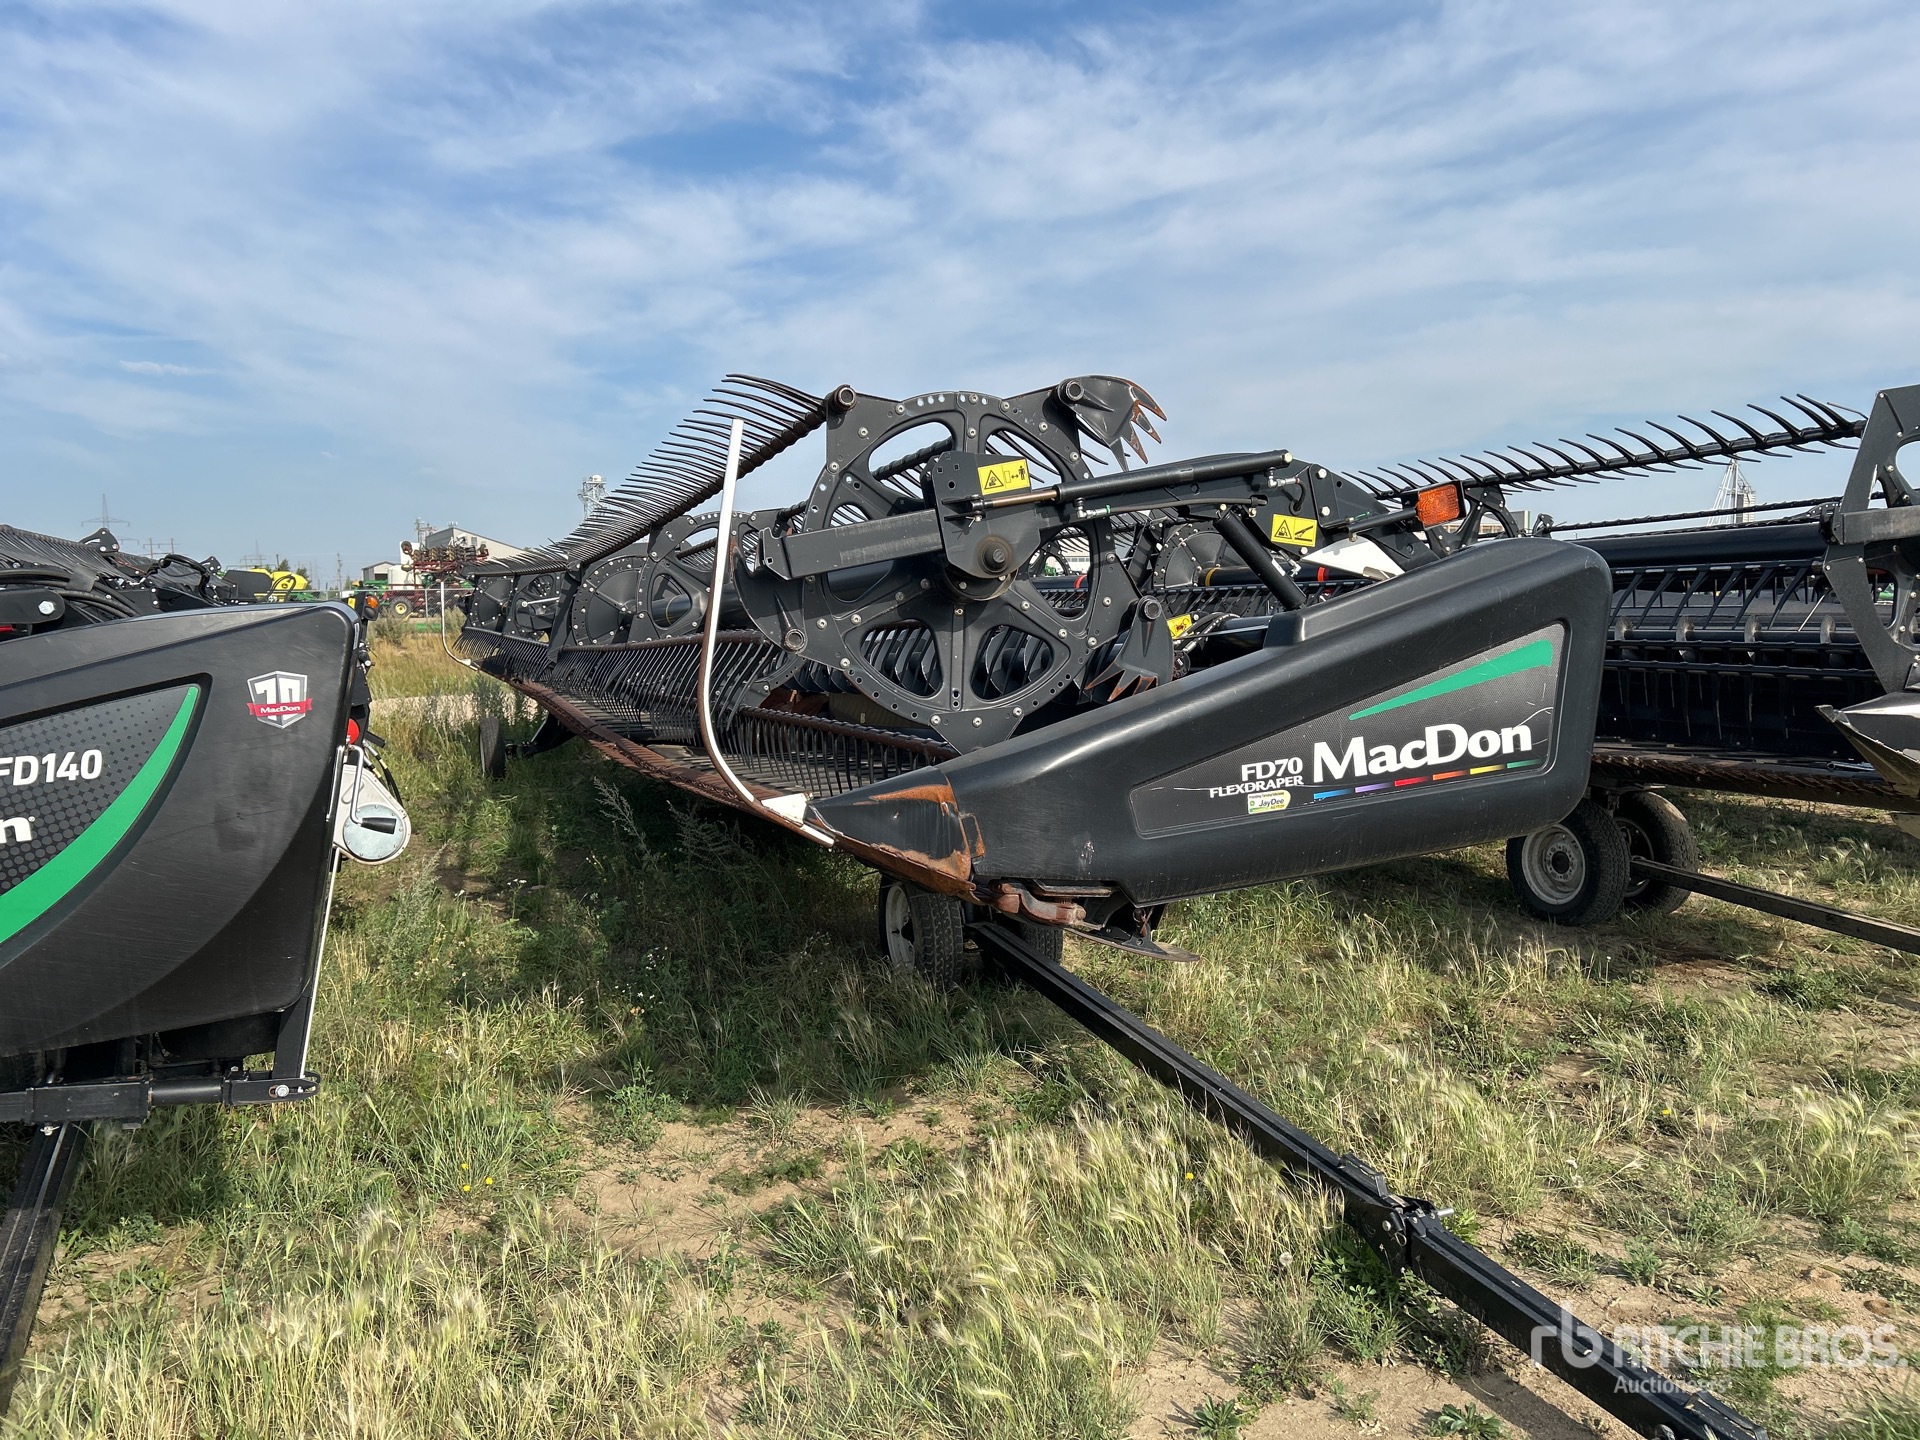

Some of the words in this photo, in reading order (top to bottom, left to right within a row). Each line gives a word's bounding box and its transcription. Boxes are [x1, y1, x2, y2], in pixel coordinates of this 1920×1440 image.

[260, 705, 301, 714] MacDon
[1313, 723, 1532, 783] MacDon
[0, 749, 103, 786] FD140
[1241, 757, 1303, 782] FD70
[1209, 775, 1304, 798] FLEXDRAPER
